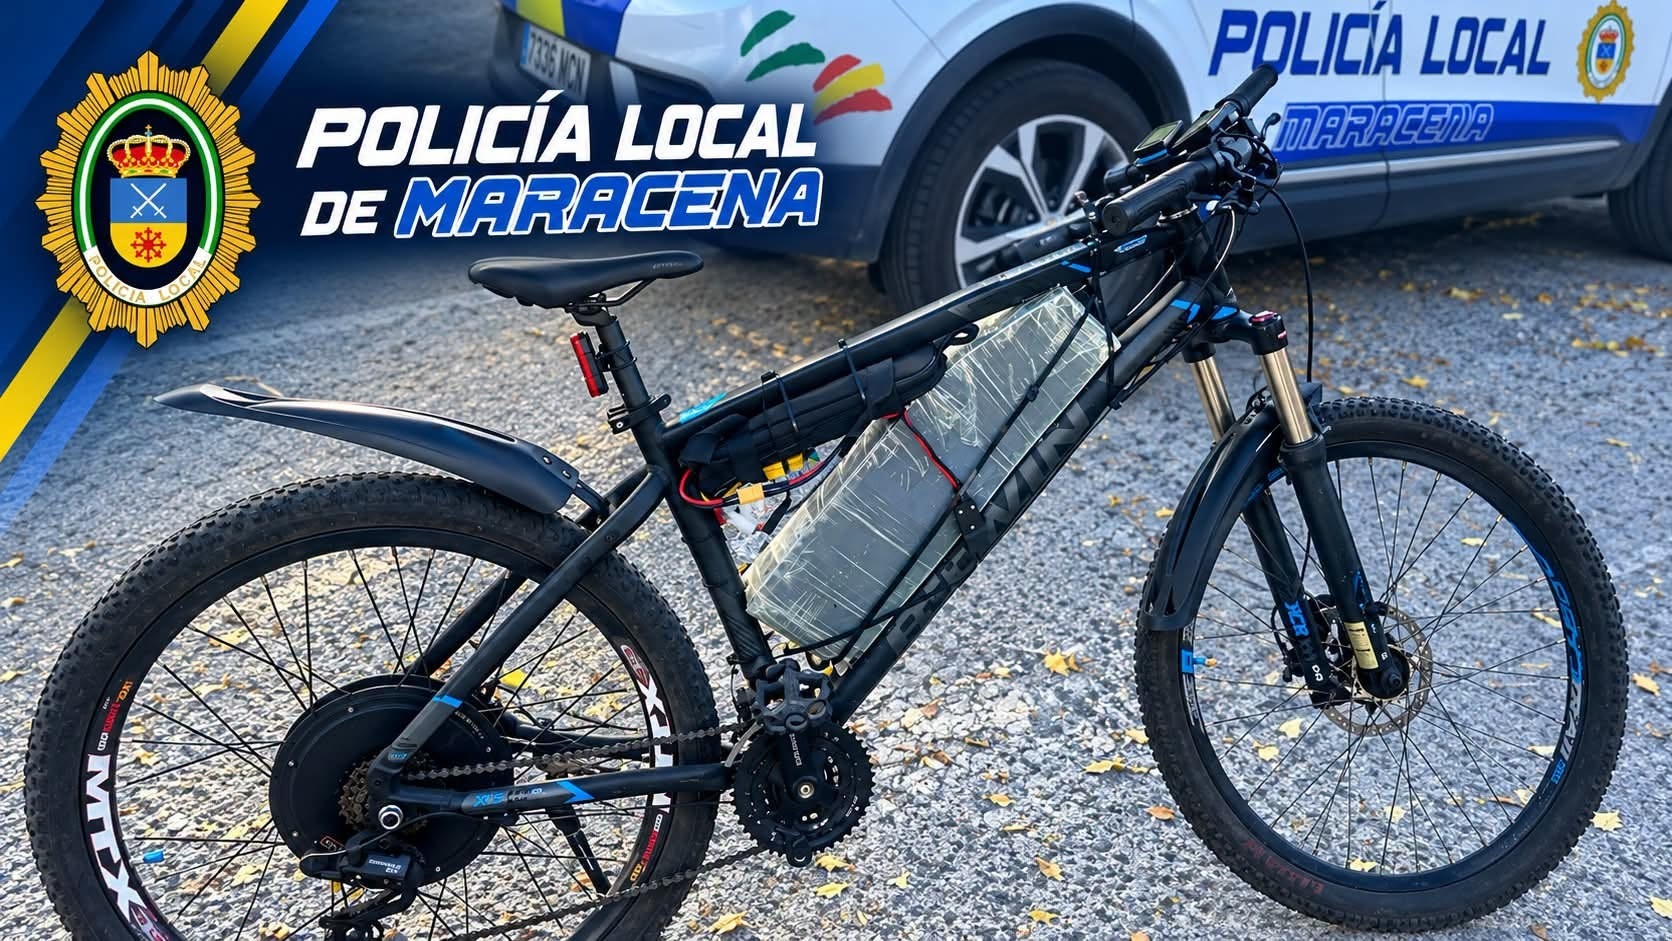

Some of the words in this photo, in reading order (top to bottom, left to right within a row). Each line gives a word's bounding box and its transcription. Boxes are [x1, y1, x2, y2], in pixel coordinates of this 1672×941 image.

[1208, 0, 1403, 76] POLICÍA
[1420, 15, 1551, 76] LOCAL
[1275, 103, 1494, 151] MARACENA
[85, 753, 147, 921] MTX
